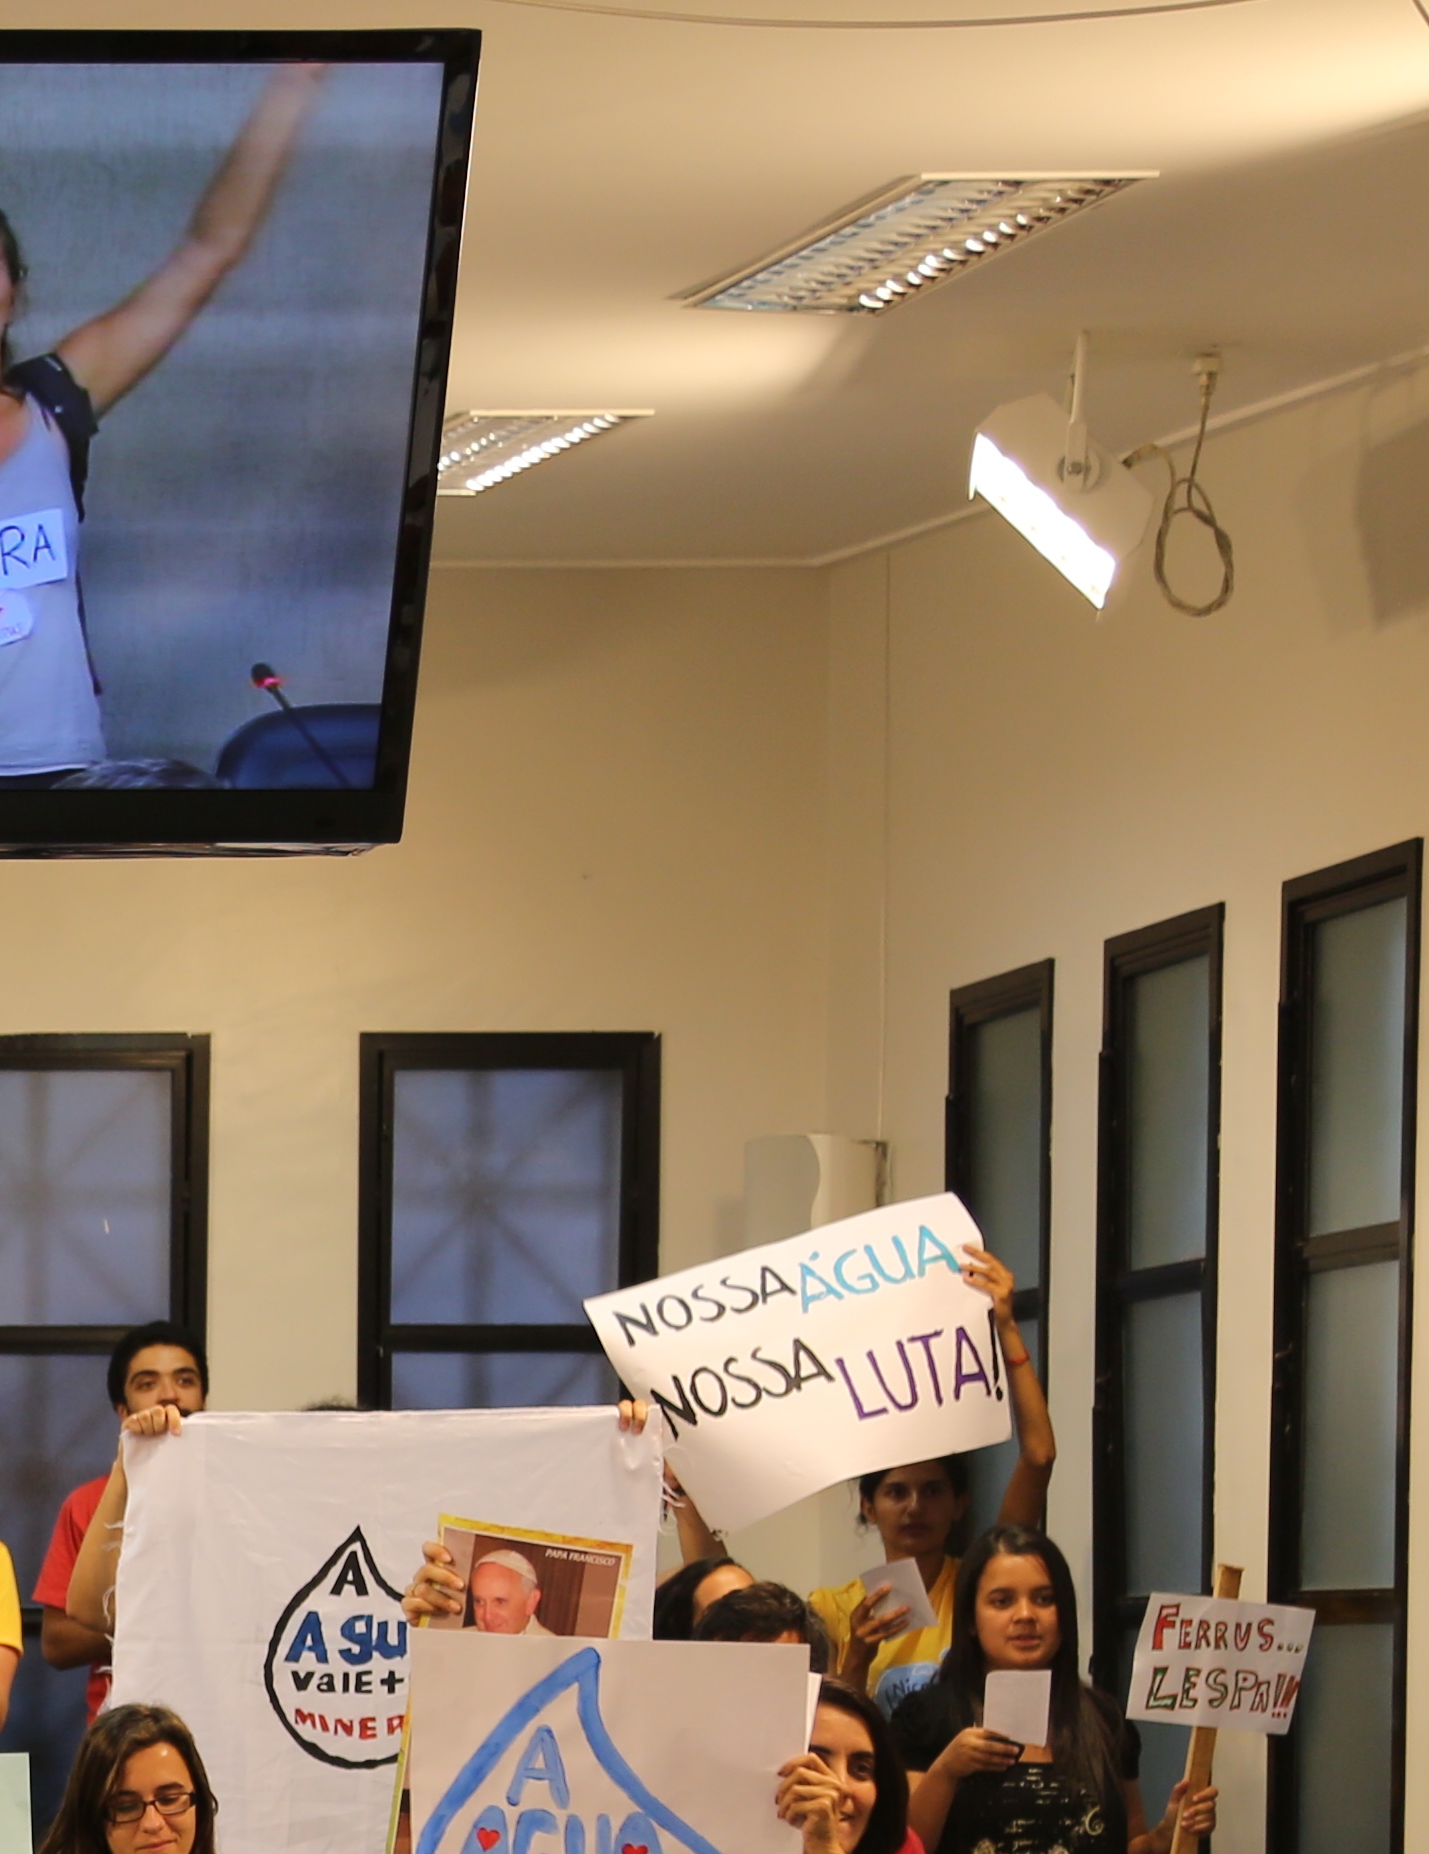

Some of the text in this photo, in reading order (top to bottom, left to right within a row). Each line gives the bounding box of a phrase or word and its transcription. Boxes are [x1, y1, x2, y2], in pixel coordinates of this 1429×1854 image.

[613, 1225, 962, 1347] NOSSA ÁGUA
[650, 1307, 1005, 1441] NOSSA LUTA!
[329, 1550, 369, 1597] A
[545, 1548, 616, 1567] PAPA FRANCISCO
[294, 1708, 409, 1741] MINER
[506, 1724, 572, 1809] A
